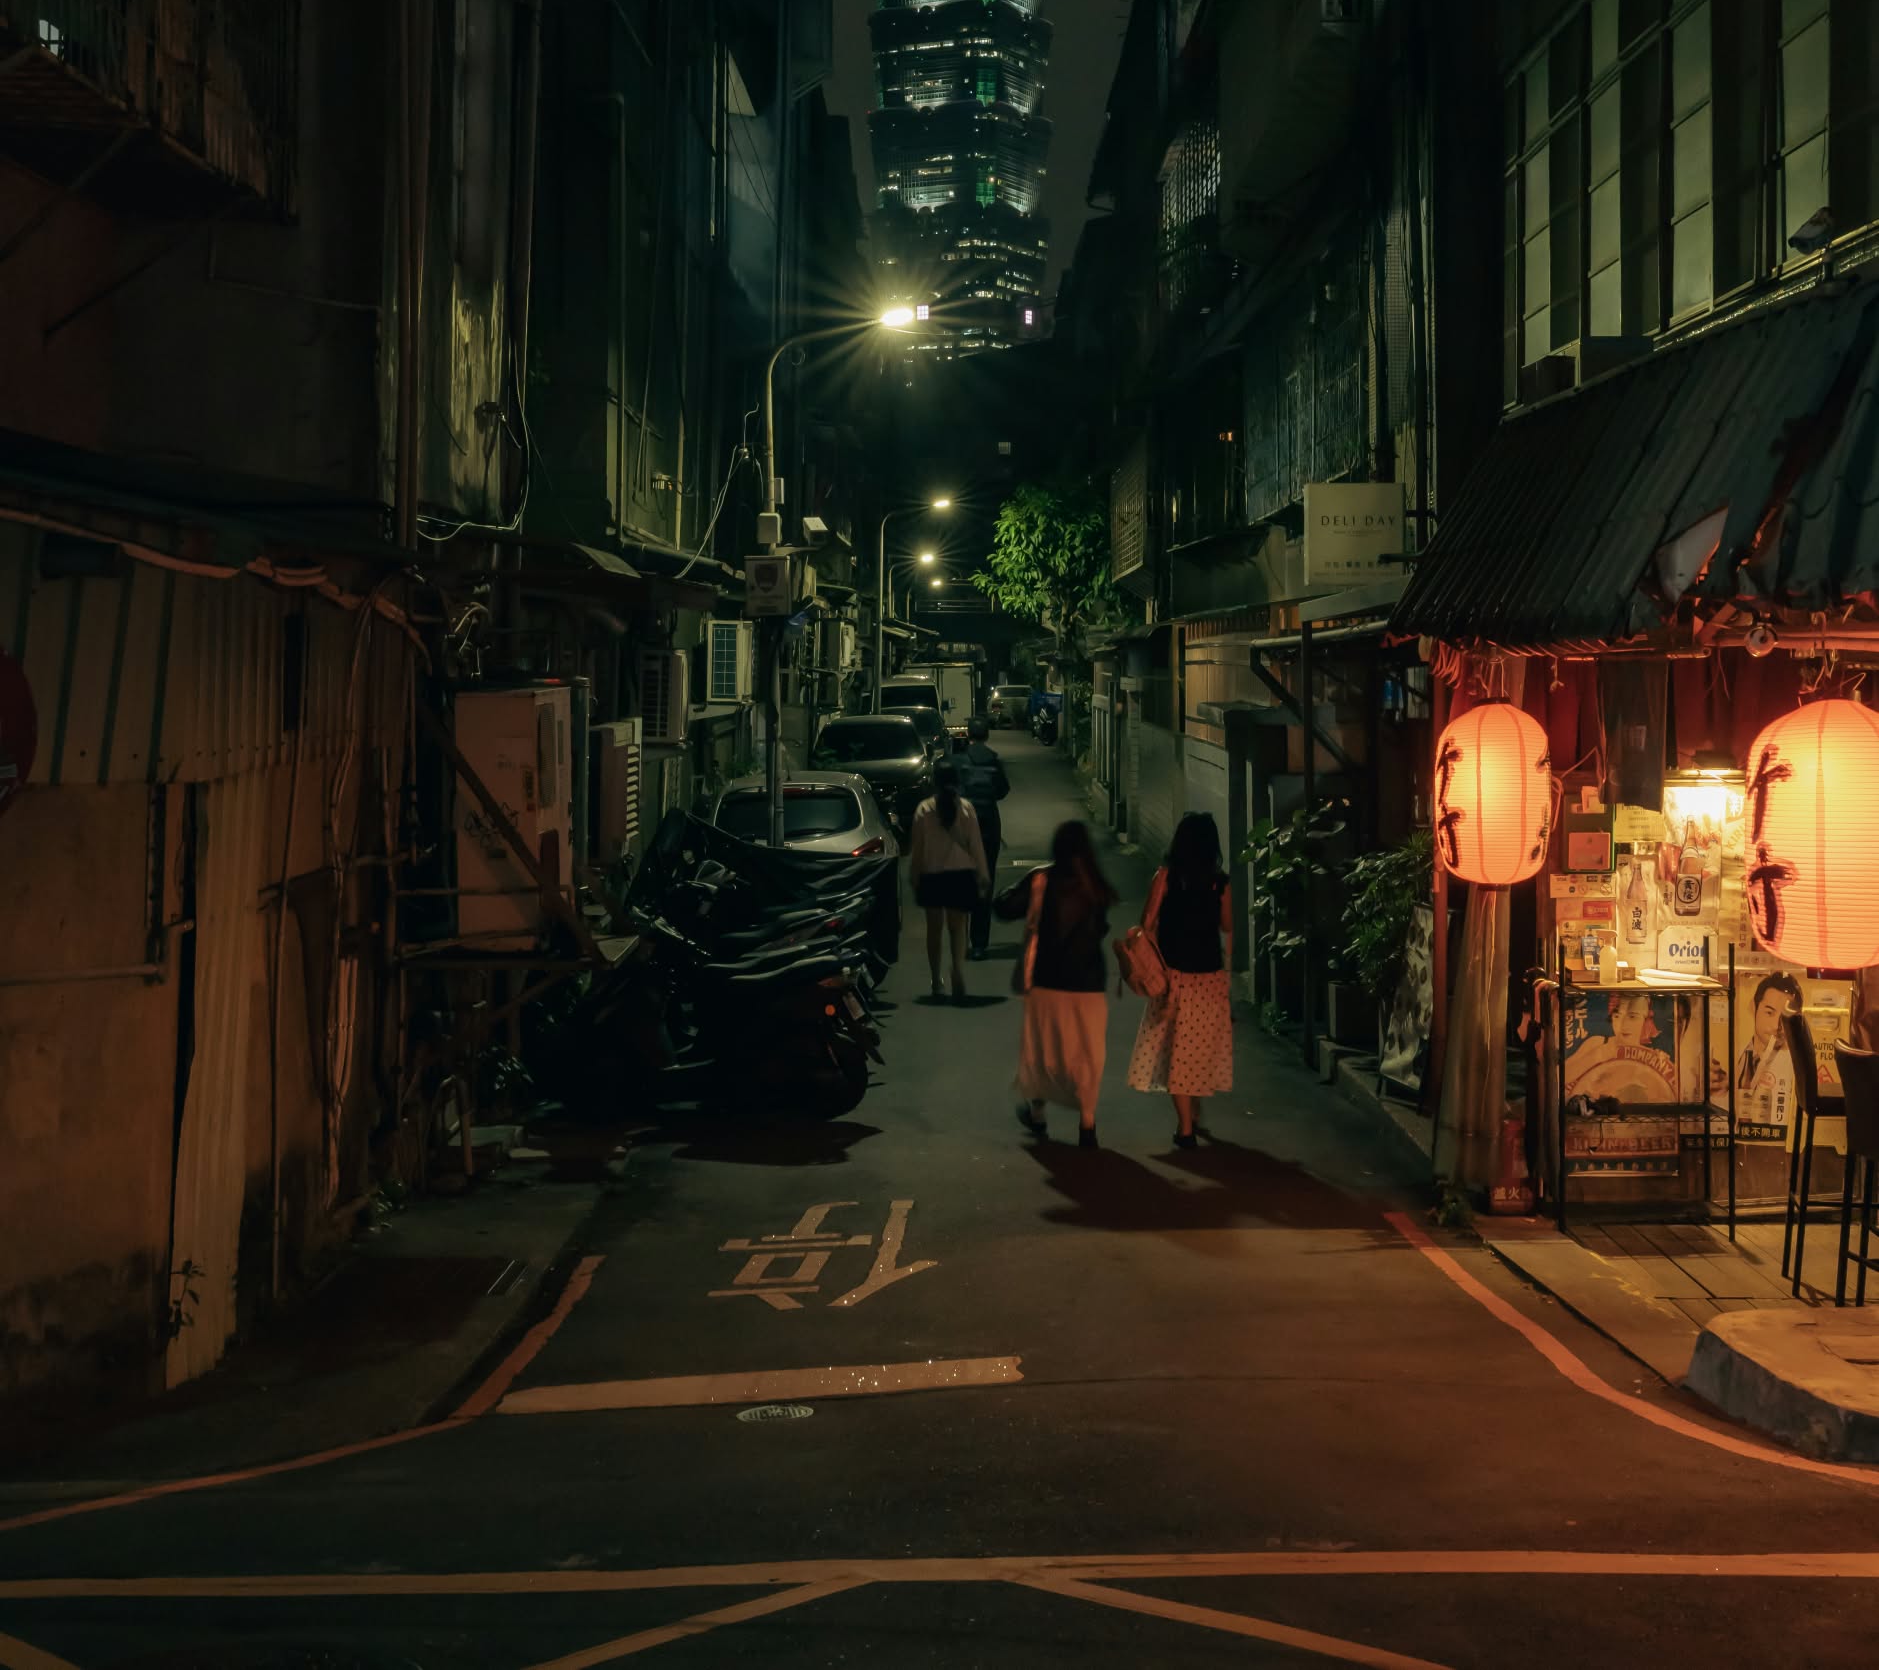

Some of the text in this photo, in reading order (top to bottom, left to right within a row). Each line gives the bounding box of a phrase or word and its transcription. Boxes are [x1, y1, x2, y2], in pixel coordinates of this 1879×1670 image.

[1320, 515, 1396, 526] DELI DAY
[1631, 906, 1643, 931] 白波
[1813, 1042, 1835, 1051] AUTIO
[1624, 1046, 1673, 1076] COMPANY
[1820, 1052, 1835, 1061] FLO
[706, 1199, 939, 1311] 停
